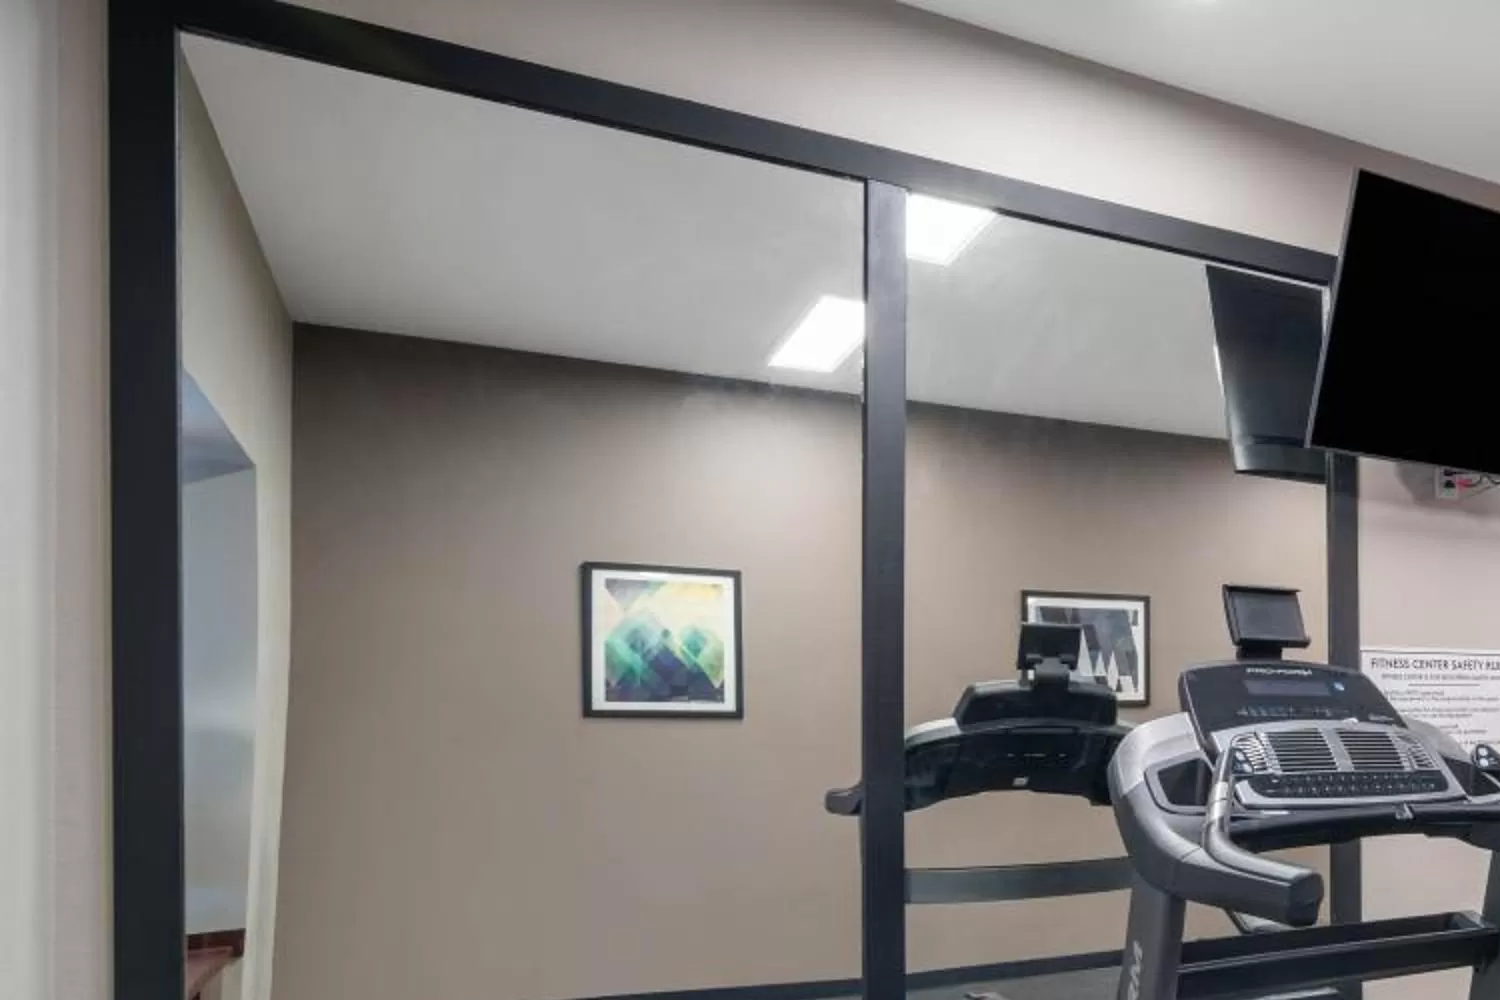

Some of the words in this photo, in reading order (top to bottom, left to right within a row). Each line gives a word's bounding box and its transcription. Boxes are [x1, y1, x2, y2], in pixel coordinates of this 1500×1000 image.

[1371, 657, 1409, 669] FITNESS
[1411, 659, 1449, 670] CENTER
[1451, 659, 1485, 671] SAFETY
